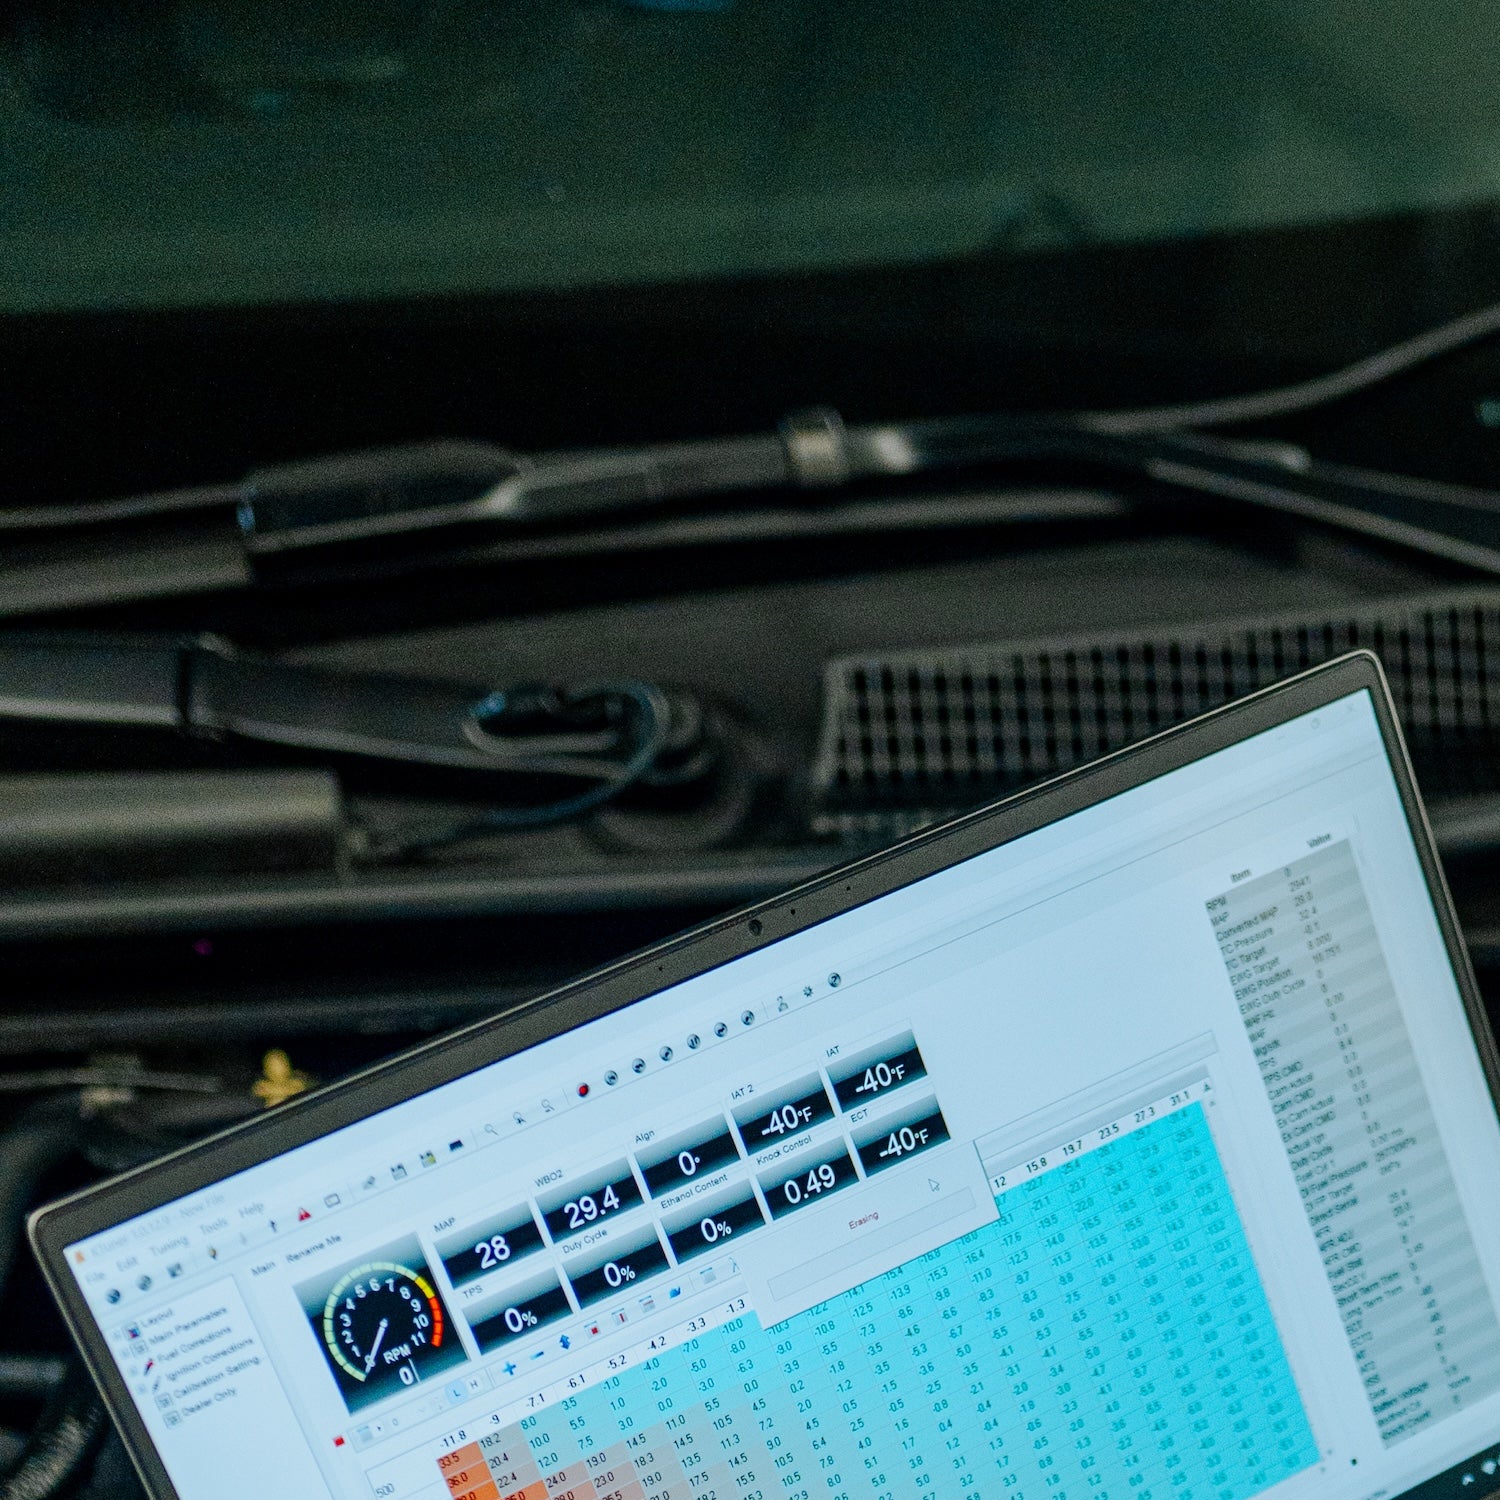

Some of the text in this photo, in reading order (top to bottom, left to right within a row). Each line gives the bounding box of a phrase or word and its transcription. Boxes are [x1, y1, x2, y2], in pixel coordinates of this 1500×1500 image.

[826, 1045, 840, 1058] IAT
[731, 1087, 746, 1101] IAT
[851, 1108, 870, 1123] ECT
[1135, 1106, 1156, 1123] 27.3
[1099, 1122, 1120, 1140] 23.5
[1062, 1139, 1084, 1157] 19.7
[1026, 1157, 1048, 1175] 15.8
[784, 1164, 836, 1204] 0.49
[994, 1176, 1007, 1189] 12
[660, 1174, 728, 1210] Ethanol Content
[563, 1185, 620, 1229] 29.4
[434, 1216, 456, 1234] MAP
[848, 1210, 880, 1230] Erasing
[701, 1217, 732, 1243] 0%
[562, 1228, 608, 1255] Duty Cycle
[474, 1235, 511, 1269] 28
[603, 1262, 636, 1288] 0%
[462, 1284, 484, 1300] TPS
[504, 1307, 538, 1333] 0%
[382, 1343, 412, 1365] RPM
[399, 1366, 414, 1386] 0
[439, 1429, 467, 1450] -11.8
[480, 1432, 501, 1449] 18.2
[488, 1453, 509, 1469] 20.4
[546, 1472, 567, 1489] 24.0
[376, 1483, 395, 1499] 500
